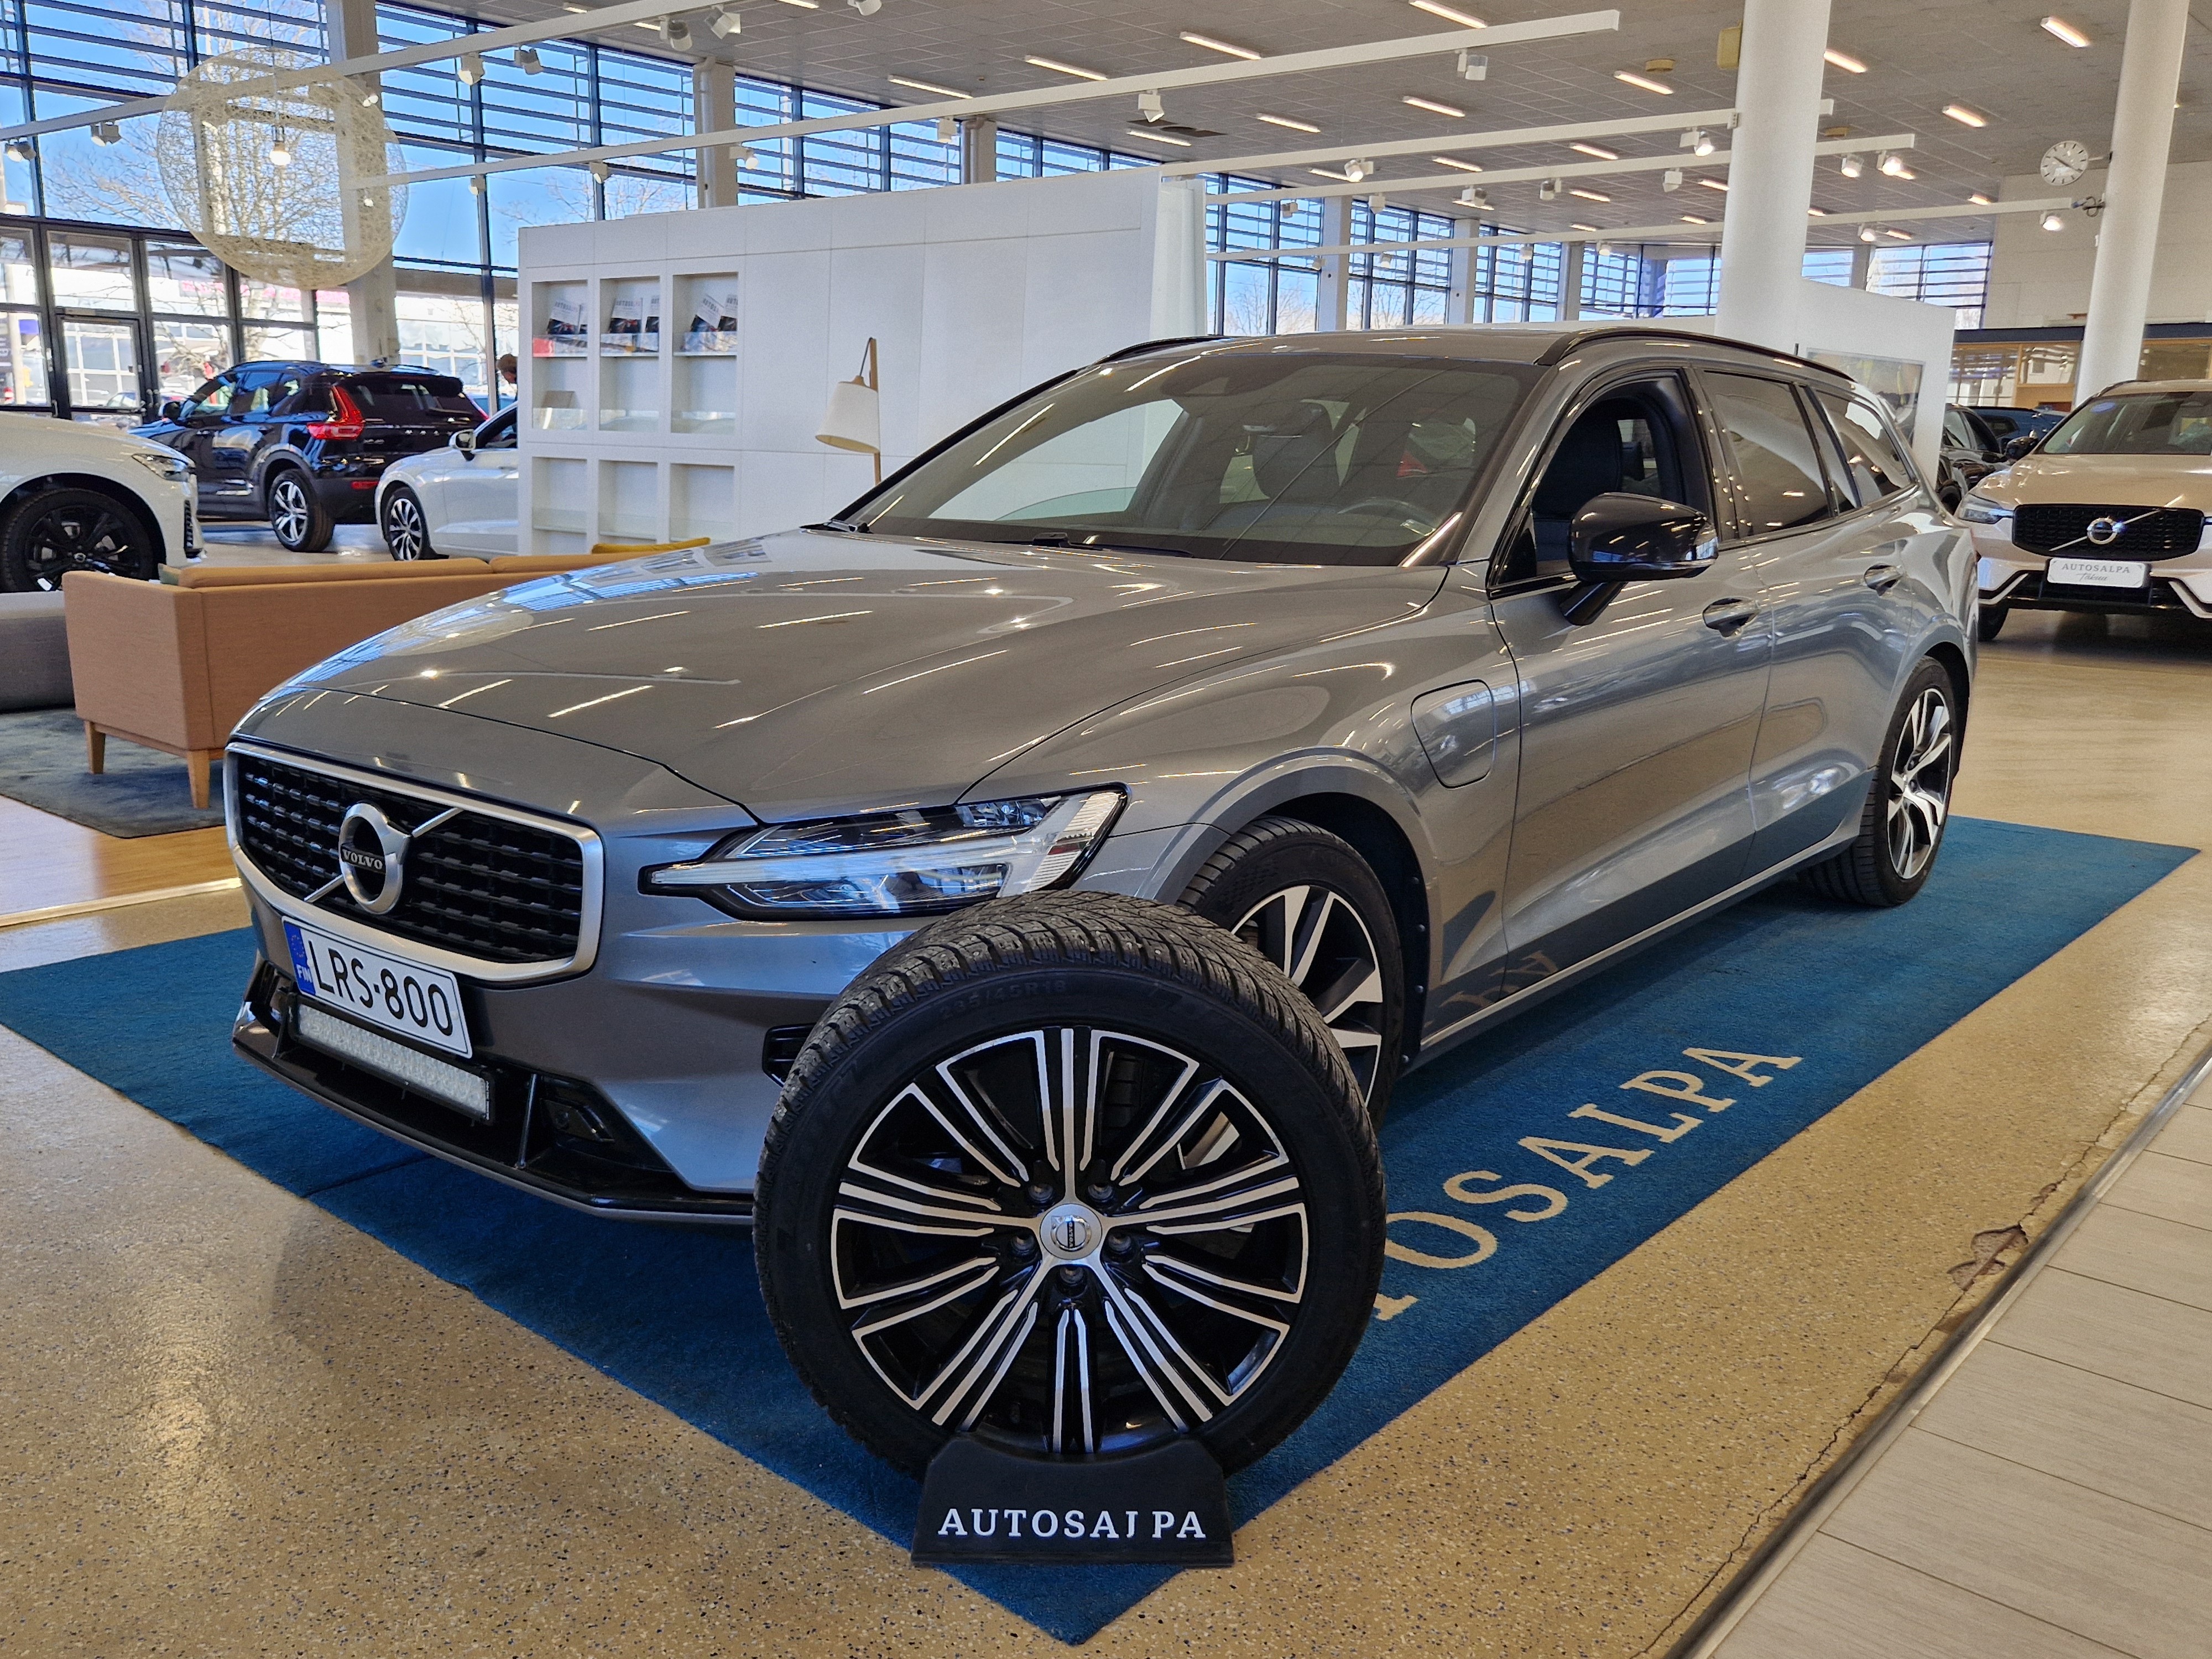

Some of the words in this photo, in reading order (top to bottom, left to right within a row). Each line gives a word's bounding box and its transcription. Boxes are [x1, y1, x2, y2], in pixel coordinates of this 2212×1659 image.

[2062, 563, 2130, 573] AUTOSALPA
[2076, 573, 2107, 581] Takuu
[342, 848, 383, 870] VOLVO
[296, 963, 312, 983] FIN
[308, 940, 453, 1036] LRS-800
[1373, 1046, 1803, 1321] OSALPA
